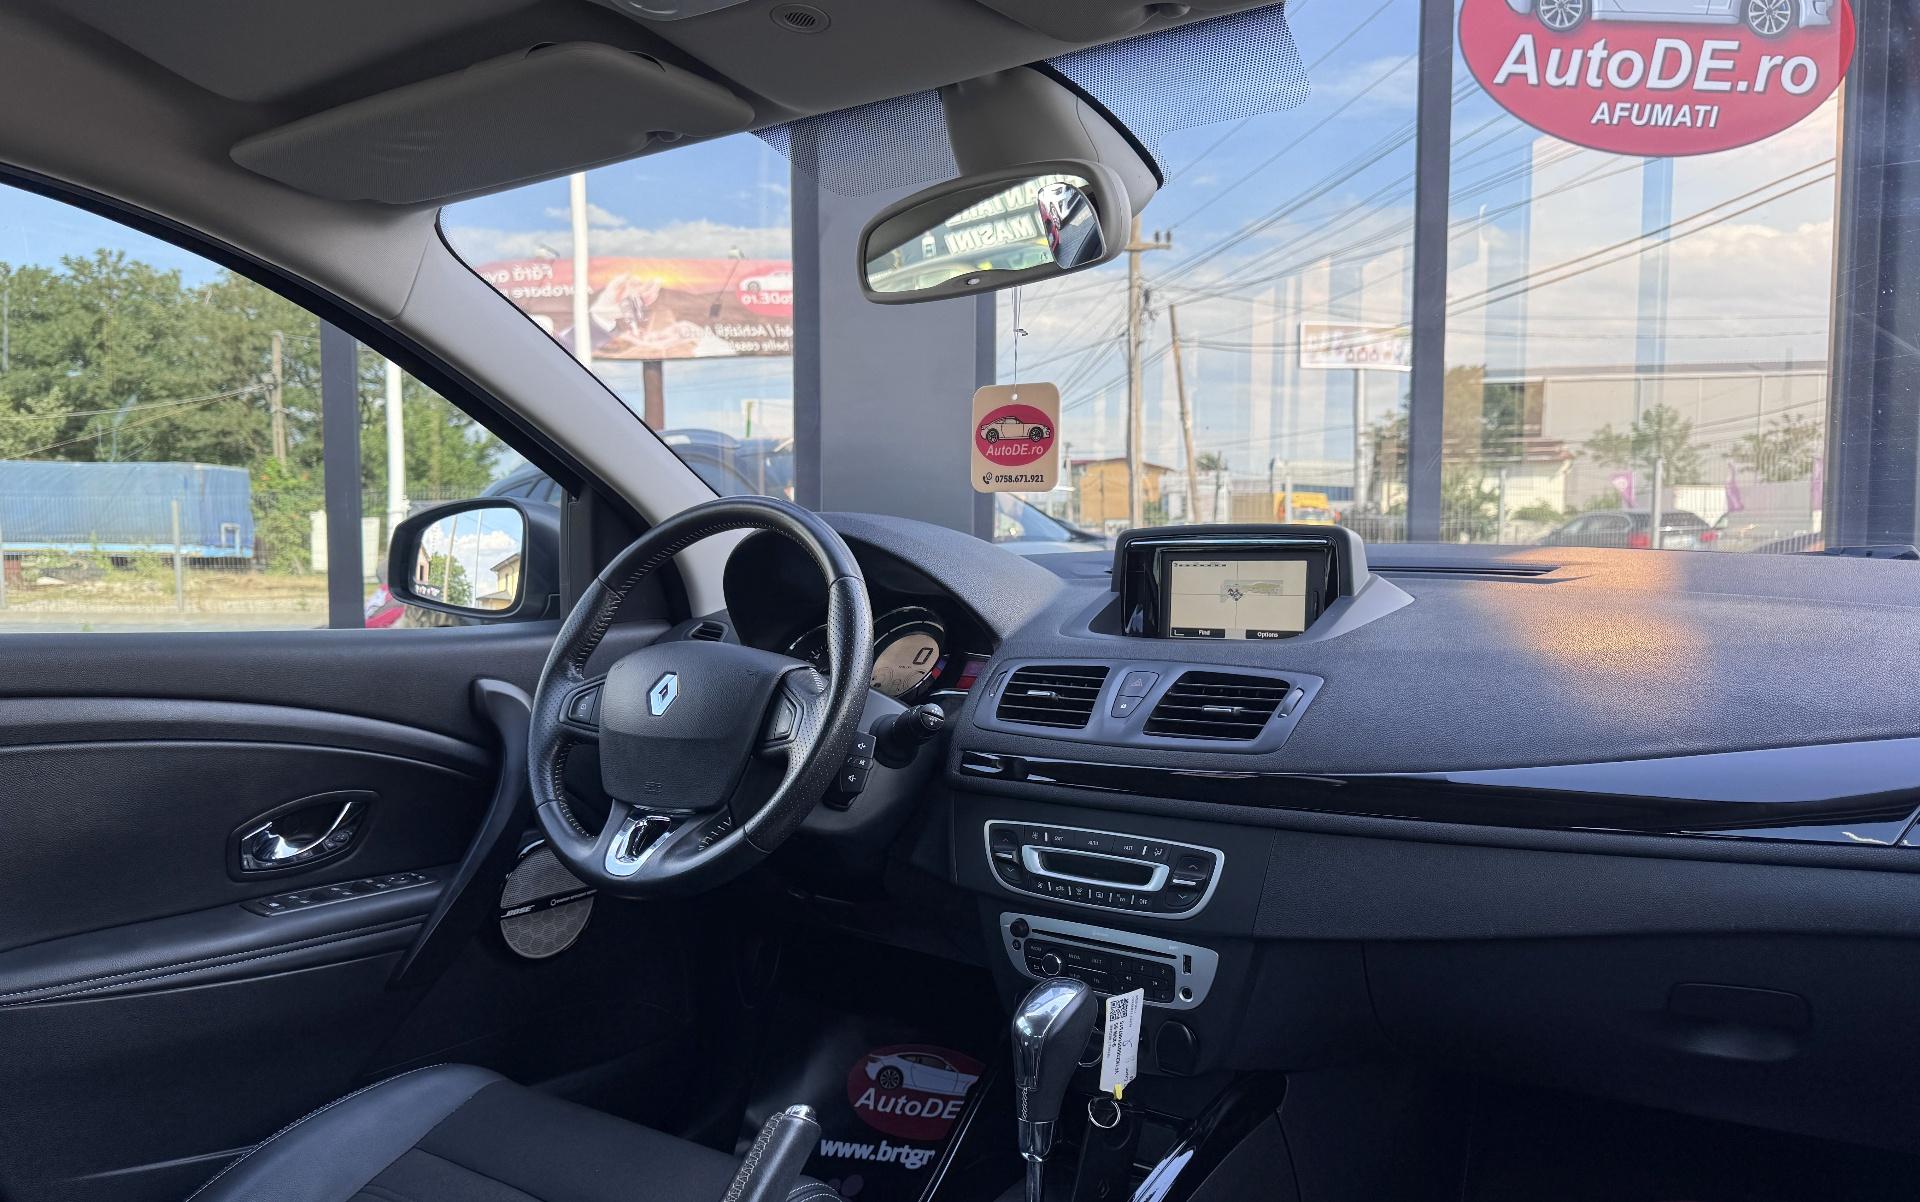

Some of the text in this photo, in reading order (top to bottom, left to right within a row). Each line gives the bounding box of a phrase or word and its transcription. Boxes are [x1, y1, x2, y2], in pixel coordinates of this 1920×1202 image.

[1493, 33, 1818, 95] AutoDE.ro
[1590, 101, 1720, 128] AFUMATI
[986, 444, 1044, 456] AutoDE.ro
[995, 474, 1045, 483] 0758.671.921
[1257, 631, 1279, 639] Options
[912, 647, 934, 665] 0
[854, 1087, 965, 1120] AutoDE
[820, 1139, 936, 1170] www.brtgr
